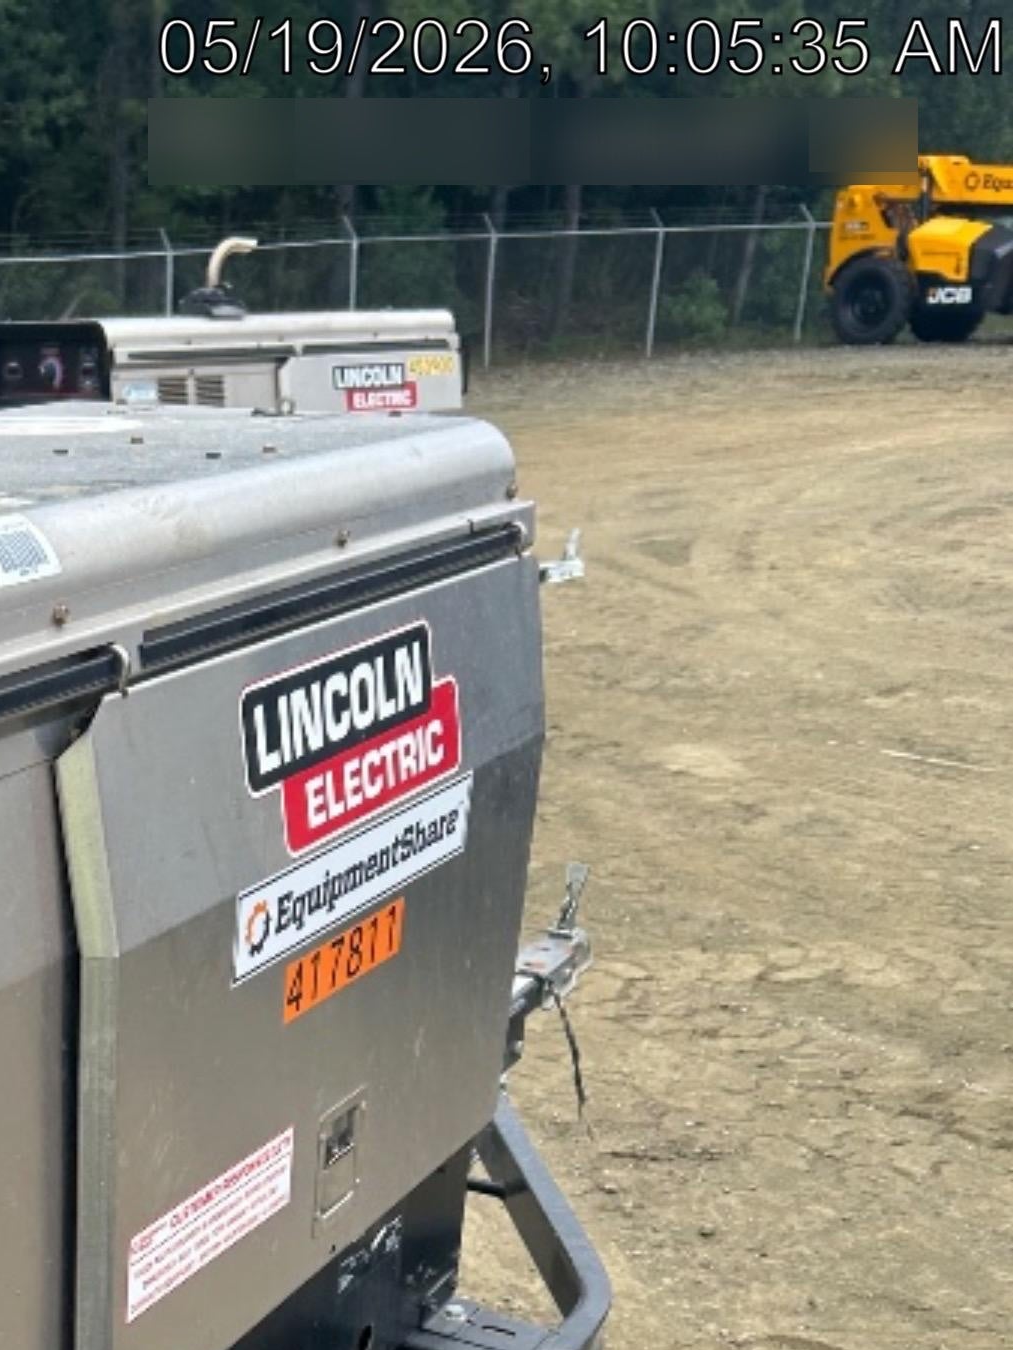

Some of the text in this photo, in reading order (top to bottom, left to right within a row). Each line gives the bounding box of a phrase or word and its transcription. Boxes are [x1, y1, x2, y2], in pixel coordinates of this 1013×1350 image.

[927, 287, 973, 304] JCB
[334, 363, 404, 388] LINCOLN
[253, 640, 425, 775] LINCOLN
[304, 718, 445, 830] ELECTRIC
[274, 805, 459, 935] EquipmentShare
[286, 904, 398, 1012] 417811
